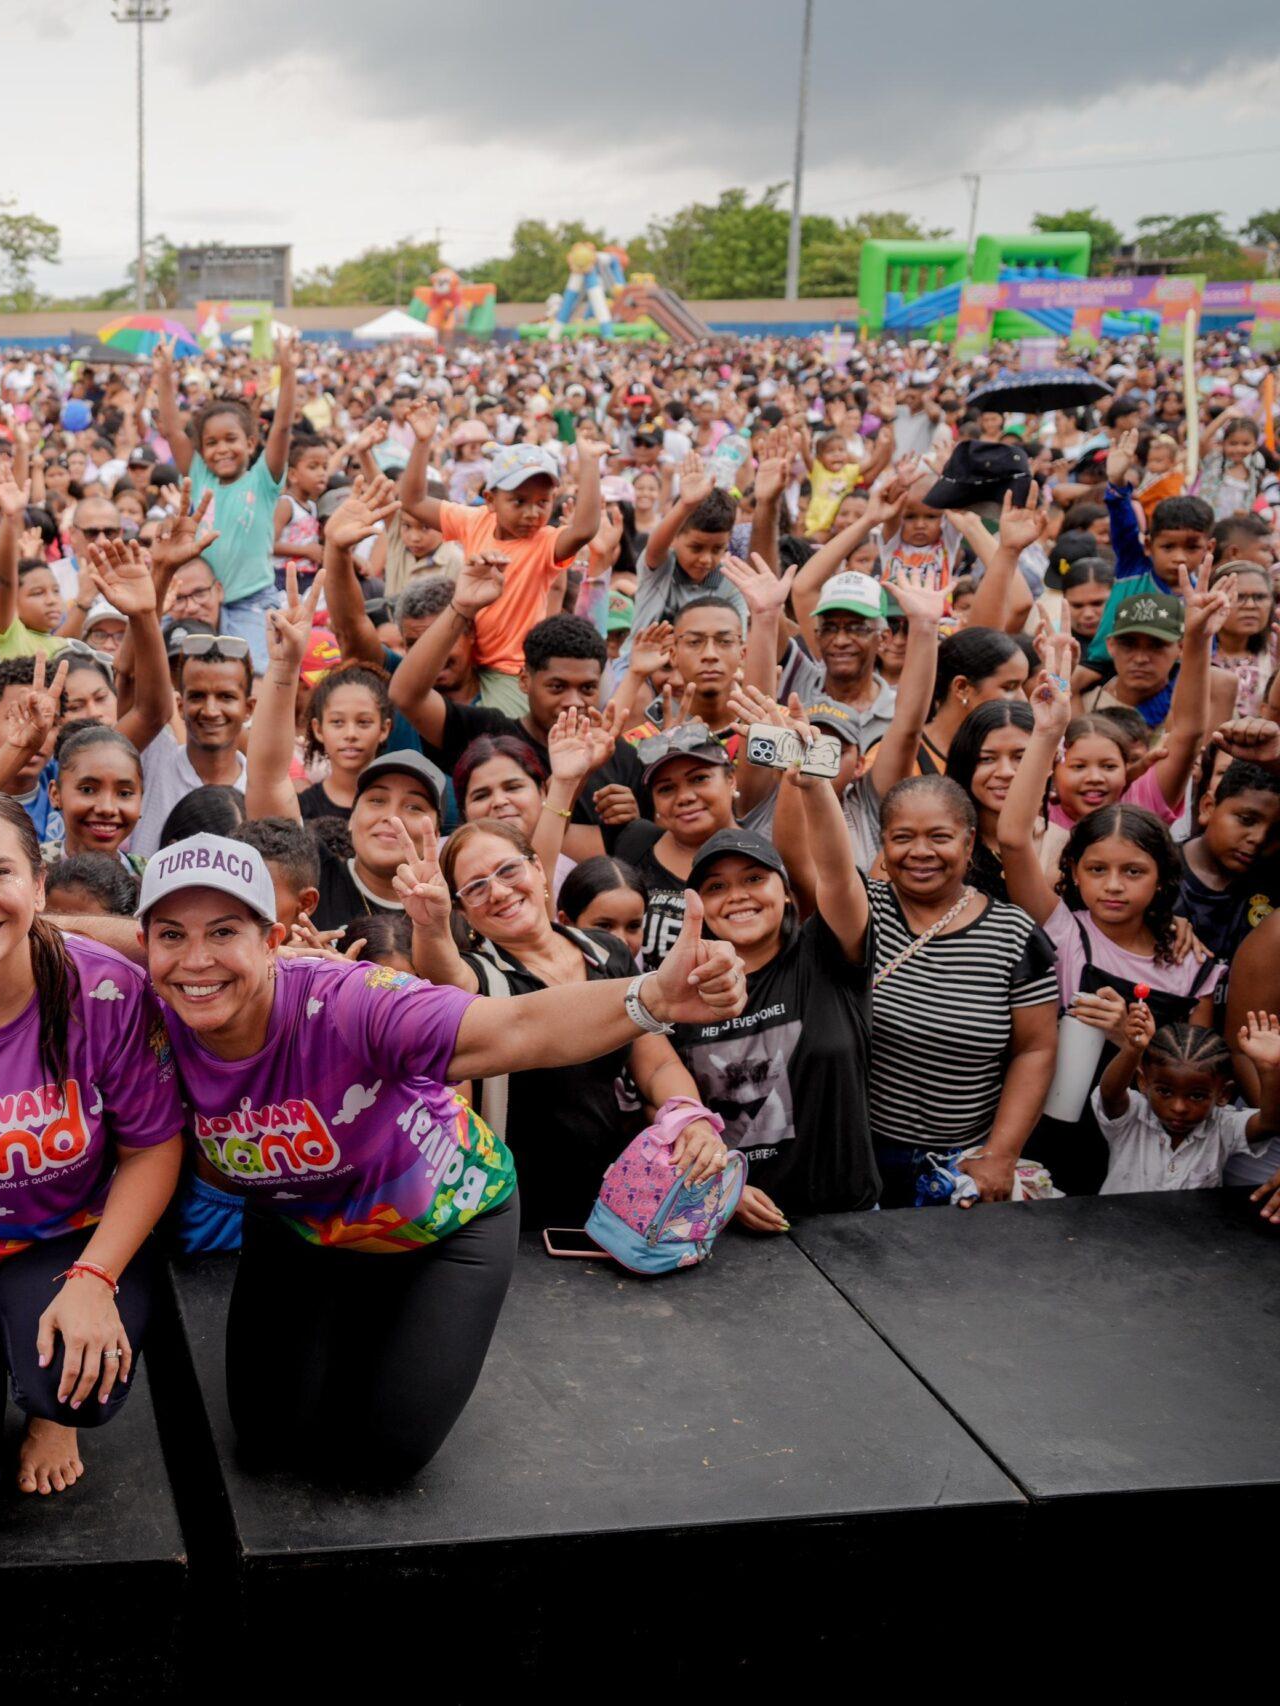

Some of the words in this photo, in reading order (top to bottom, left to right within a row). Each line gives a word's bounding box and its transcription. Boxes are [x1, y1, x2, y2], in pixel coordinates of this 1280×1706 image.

[158, 848, 253, 883] TURBACO
[20, 1179, 29, 1187] SE
[32, 1171, 59, 1185] QUEDÓ
[61, 1168, 69, 1177] A
